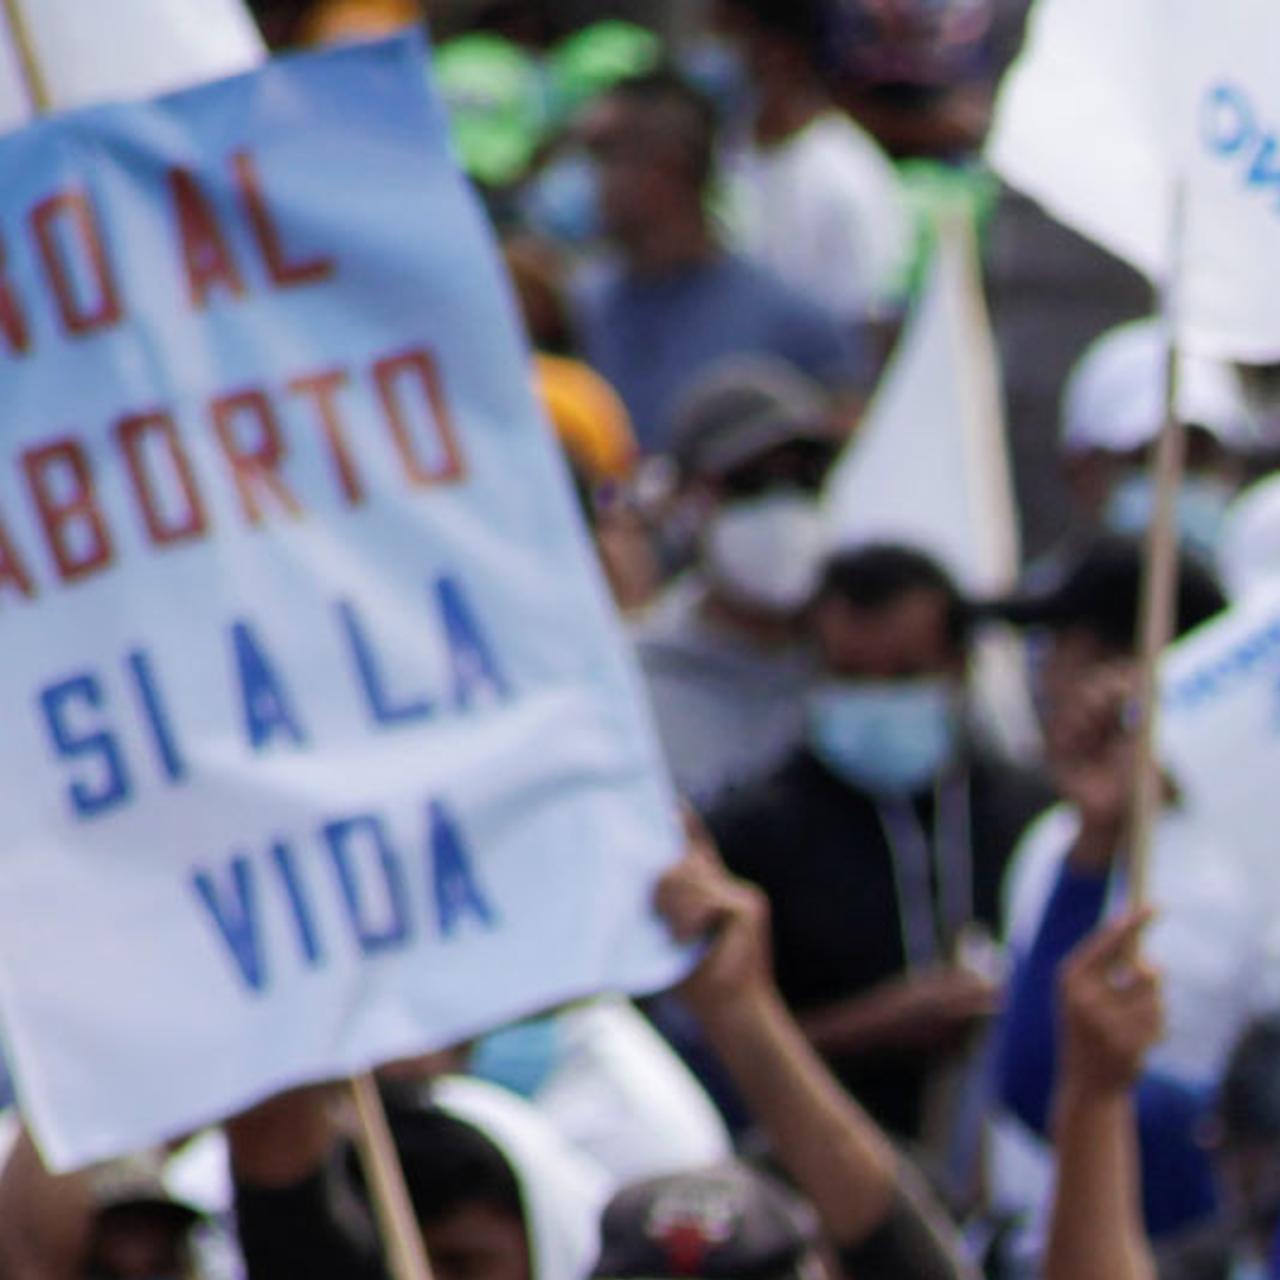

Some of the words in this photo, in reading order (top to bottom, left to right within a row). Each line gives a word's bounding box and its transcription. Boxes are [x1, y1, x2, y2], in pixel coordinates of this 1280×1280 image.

[168, 147, 336, 310] AL
[40, 642, 186, 820] SI
[232, 614, 310, 757] A
[338, 570, 513, 728] LA
[192, 795, 498, 994] VIDA
